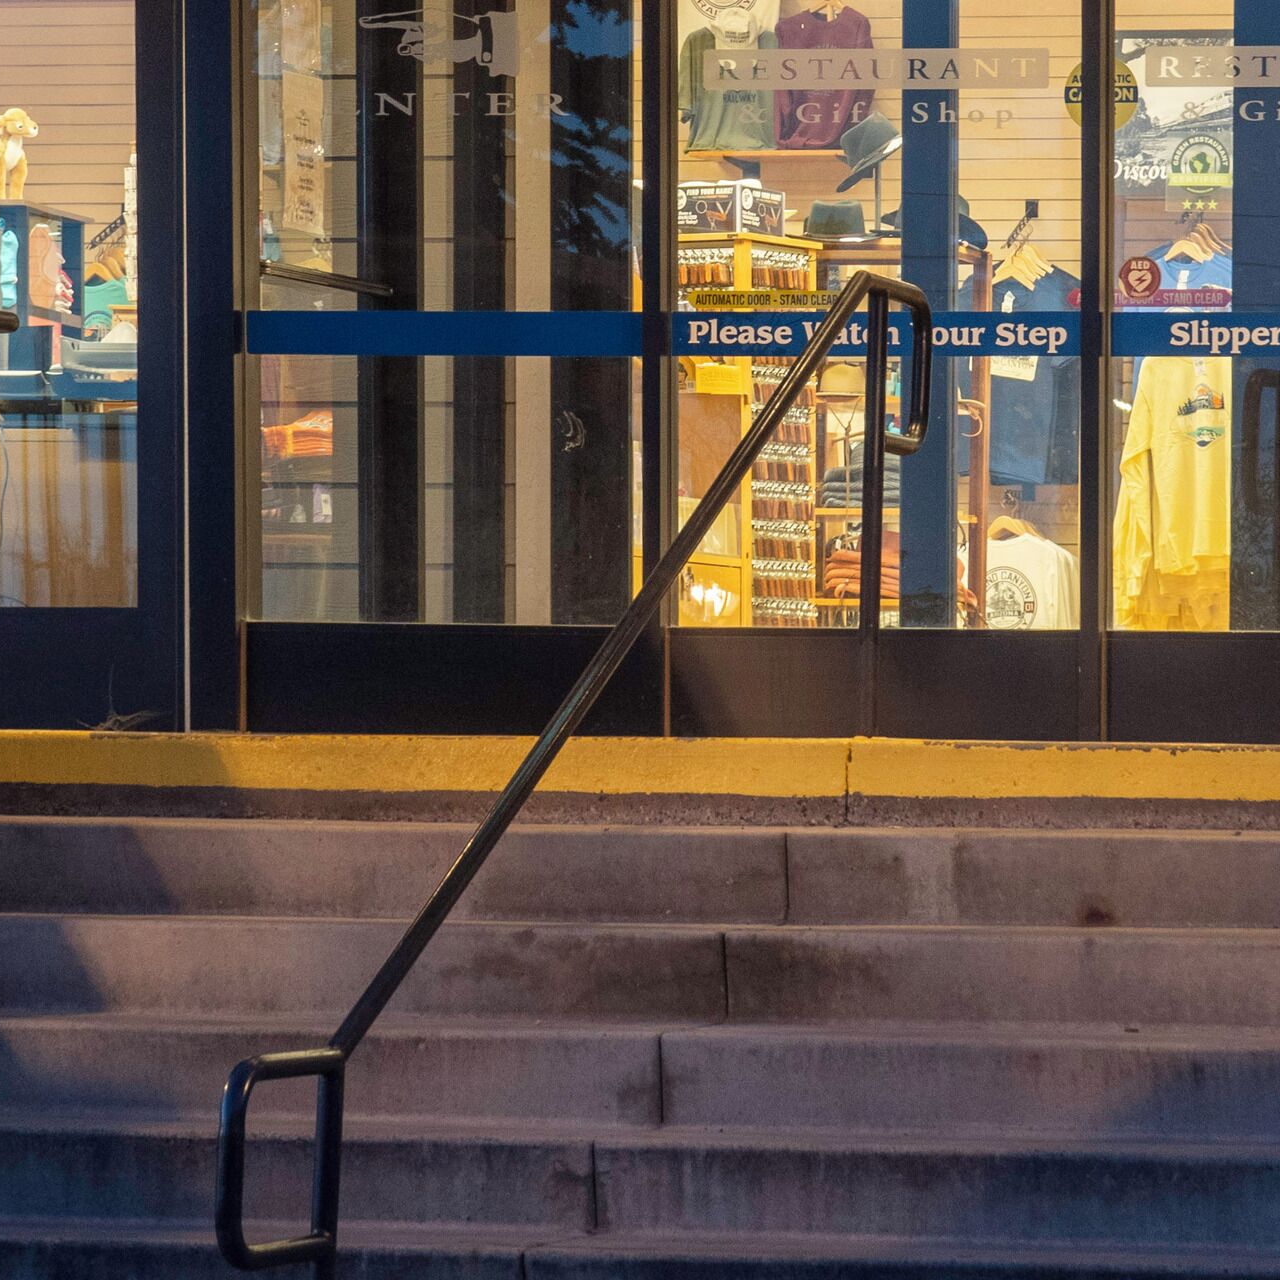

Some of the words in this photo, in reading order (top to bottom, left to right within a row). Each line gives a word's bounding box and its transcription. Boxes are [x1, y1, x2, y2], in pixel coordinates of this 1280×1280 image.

[716, 57, 1037, 81] RESTAURANT
[355, 92, 573, 117] NTER
[796, 101, 873, 124] Gif
[911, 101, 1015, 131] Shop
[1188, 135, 1229, 166] RESTAURANT
[1130, 261, 1151, 270] AED
[695, 293, 745, 306] AUTOMATIC
[747, 293, 771, 306] DOOR
[780, 293, 808, 306] STAND
[1162, 292, 1193, 305] STAND
[1194, 292, 1224, 305] CLEAR
[687, 318, 793, 345] Please
[910, 322, 986, 346] our
[995, 322, 1068, 354] Step
